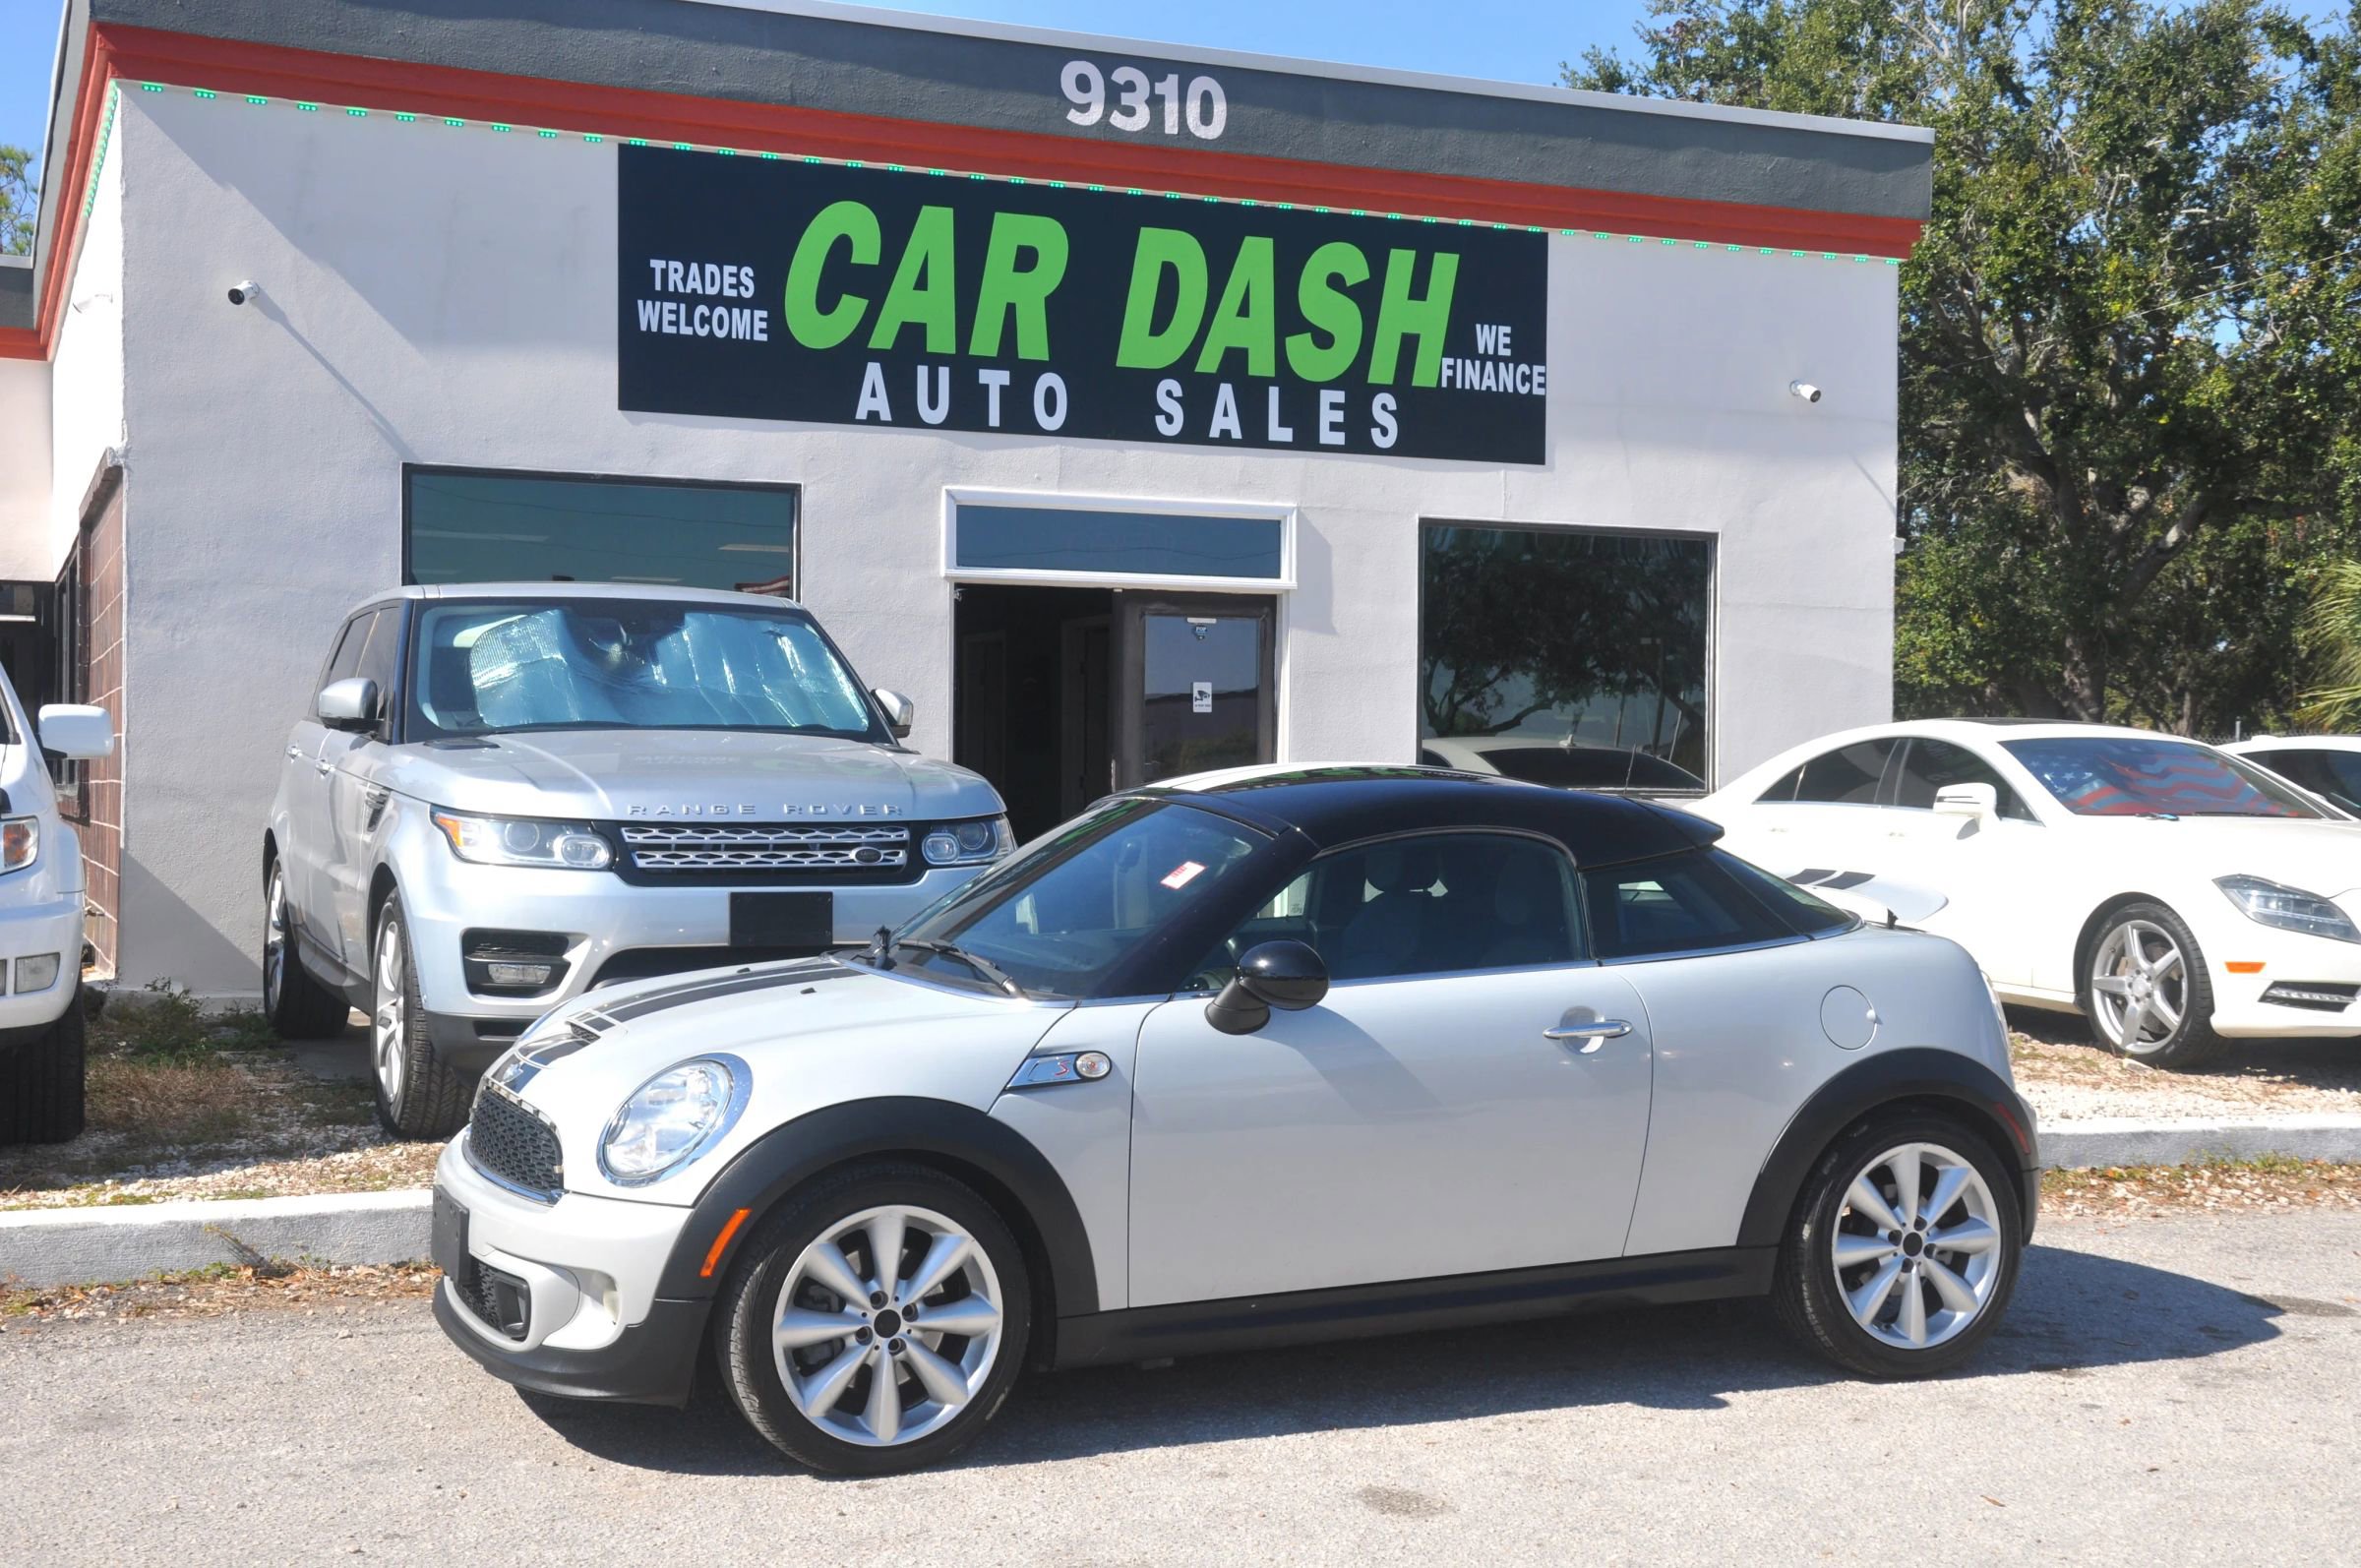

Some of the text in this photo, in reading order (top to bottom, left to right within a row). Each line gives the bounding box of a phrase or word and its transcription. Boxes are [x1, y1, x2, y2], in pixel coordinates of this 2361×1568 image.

[1060, 60, 1228, 141] 9310
[649, 259, 755, 299] TRADES
[785, 201, 1459, 387] CAR DASH
[636, 299, 768, 341] WELCOME
[1476, 324, 1512, 356] WE
[1441, 357, 1546, 395] FINANCE
[855, 361, 1398, 449] AUTO SALES
[628, 804, 903, 816] RANGE ROVER
